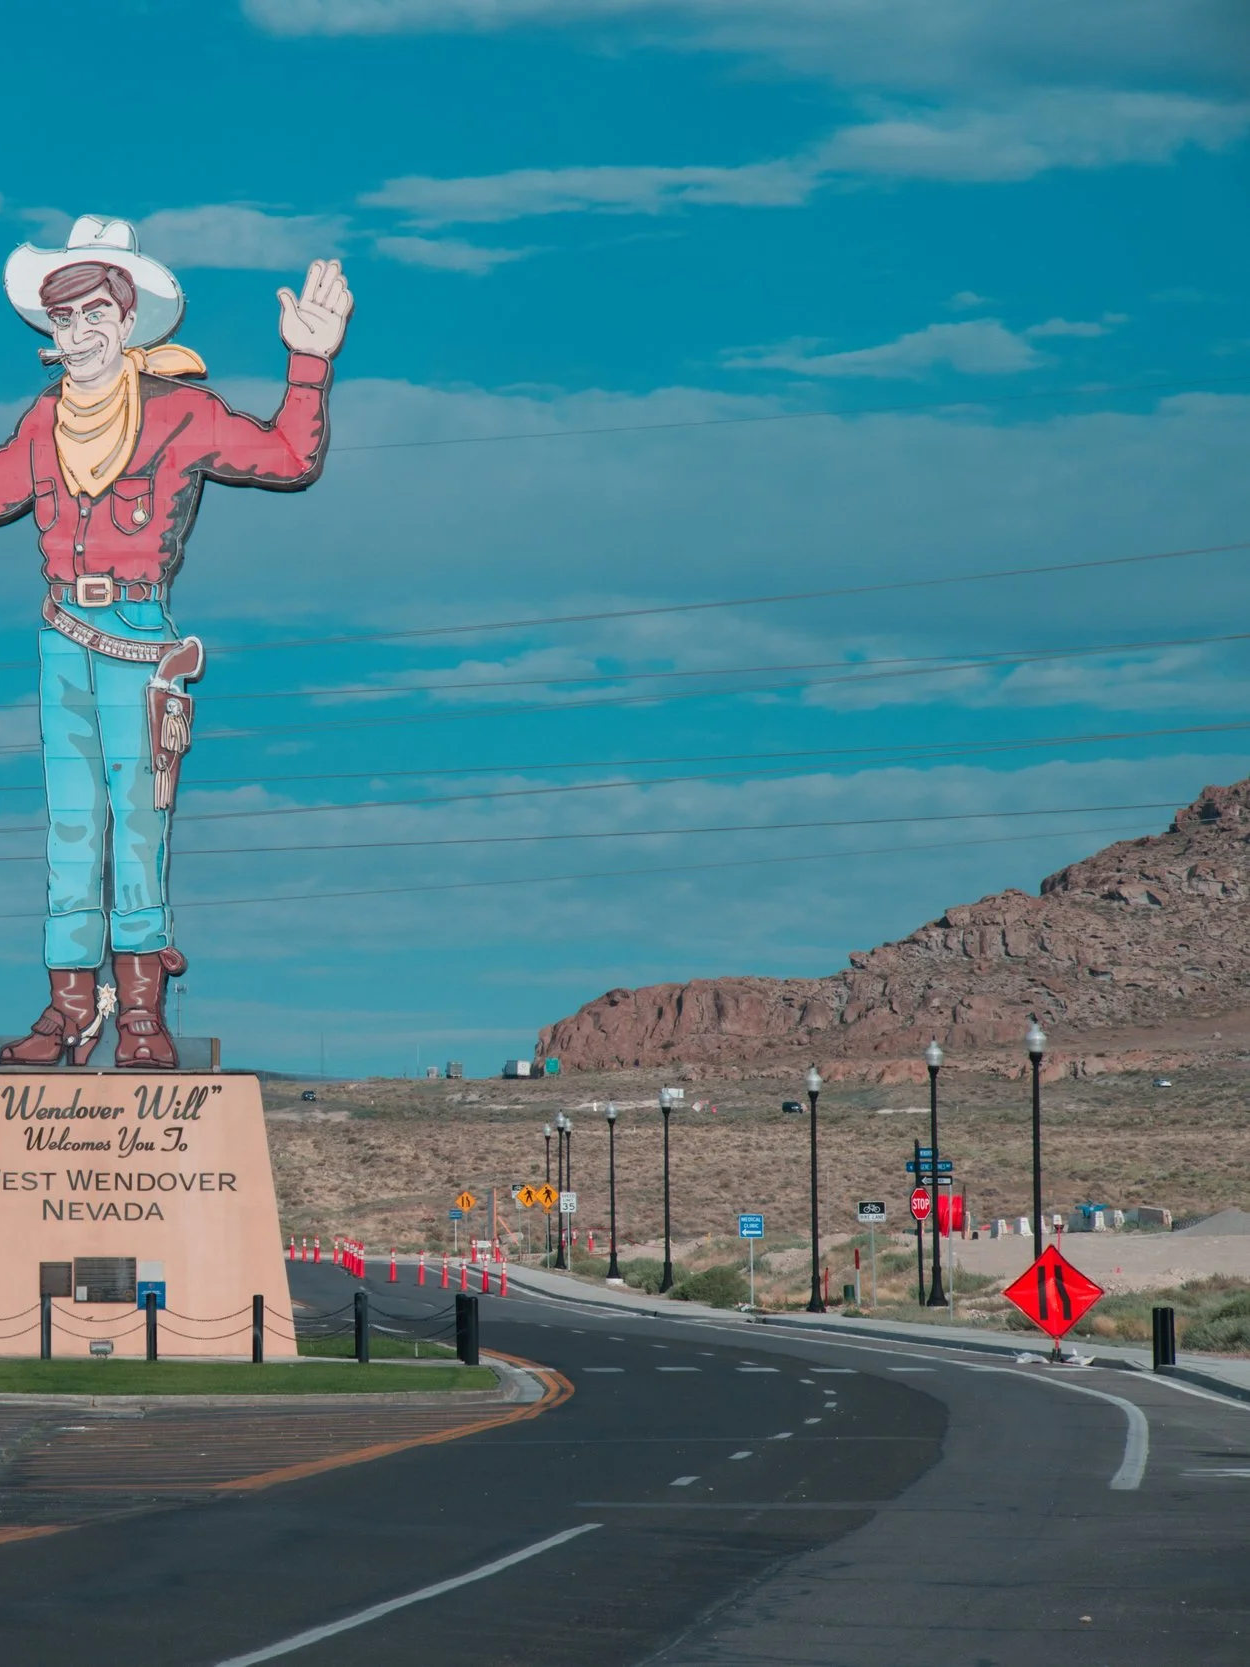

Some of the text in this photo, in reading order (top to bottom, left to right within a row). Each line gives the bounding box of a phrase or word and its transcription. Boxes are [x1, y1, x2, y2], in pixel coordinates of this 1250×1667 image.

[134, 1085, 222, 1120] Will”
[24, 1126, 188, 1158] Welcomes You To
[66, 1169, 237, 1191] WENDOVER
[42, 1199, 164, 1221] NEVADA
[912, 1199, 929, 1210] STOP
